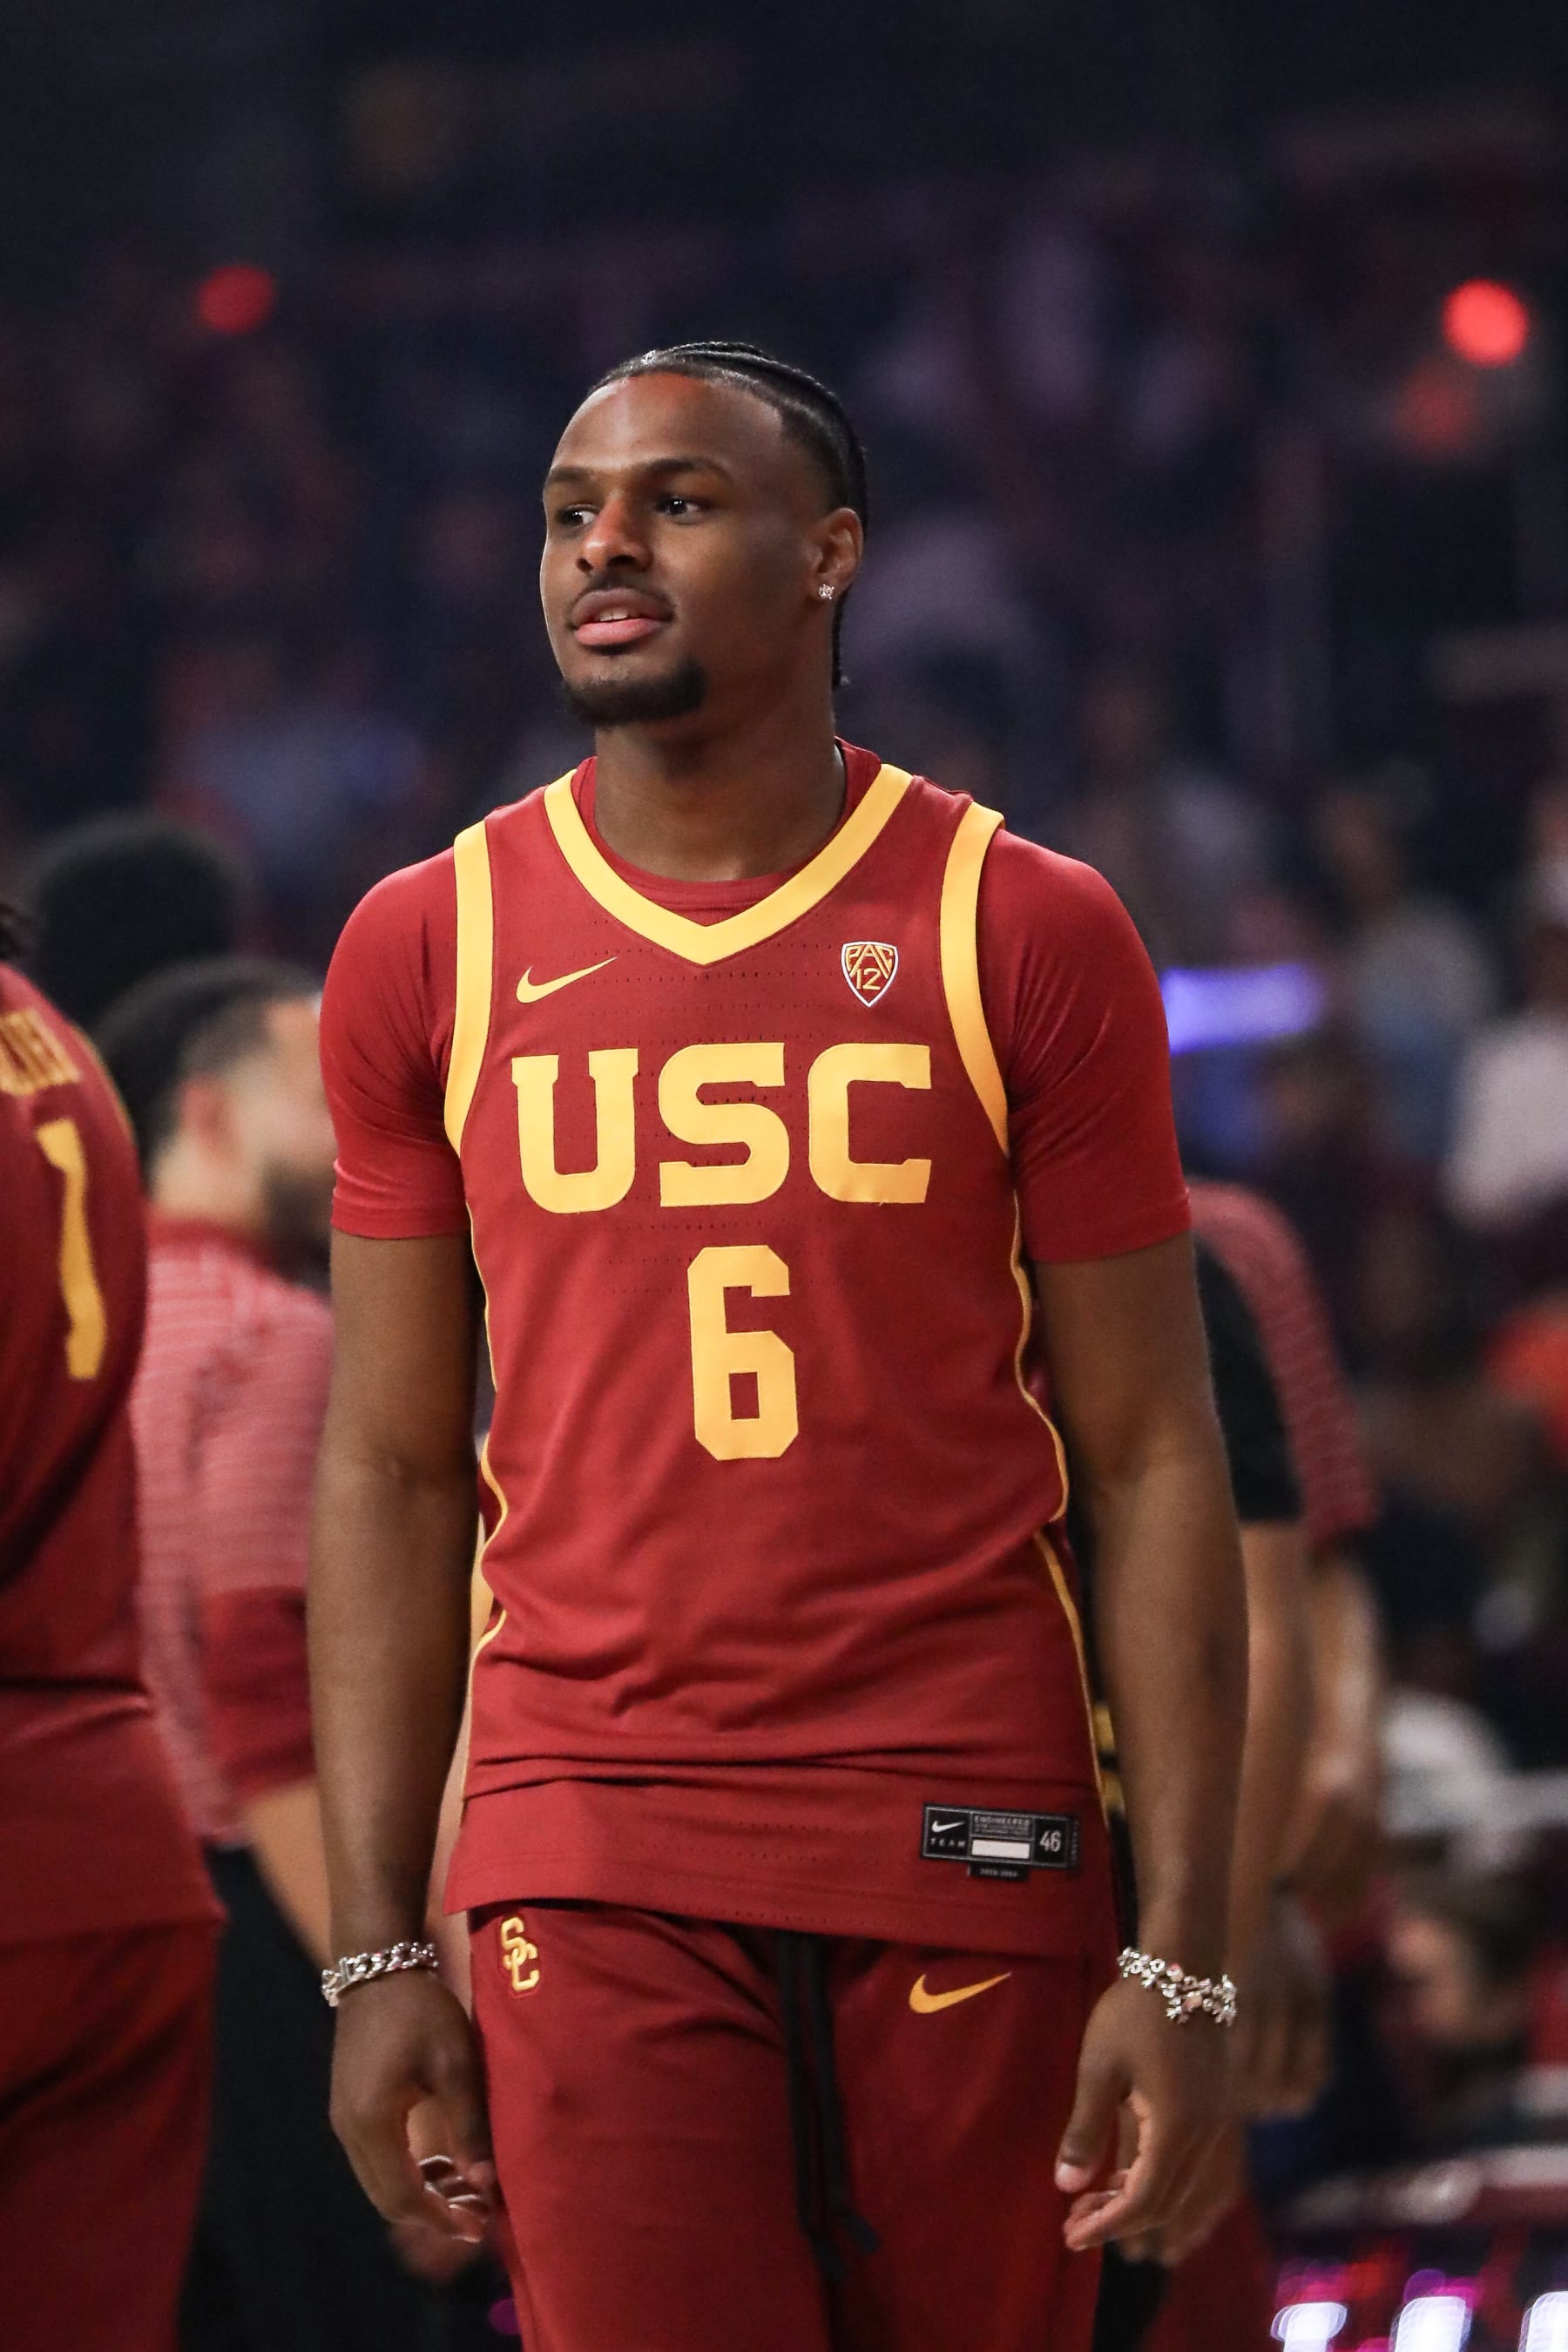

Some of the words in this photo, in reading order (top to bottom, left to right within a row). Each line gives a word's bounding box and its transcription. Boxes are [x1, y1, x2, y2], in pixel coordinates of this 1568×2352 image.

[845, 944, 893, 979] PAC
[856, 968, 881, 990] 12
[511, 1042, 932, 1214] USC
[36, 1119, 106, 1379] 1
[687, 1245, 799, 1461] 6
[930, 1837, 966, 1848] TEAM
[1039, 1830, 1061, 1852] 46
